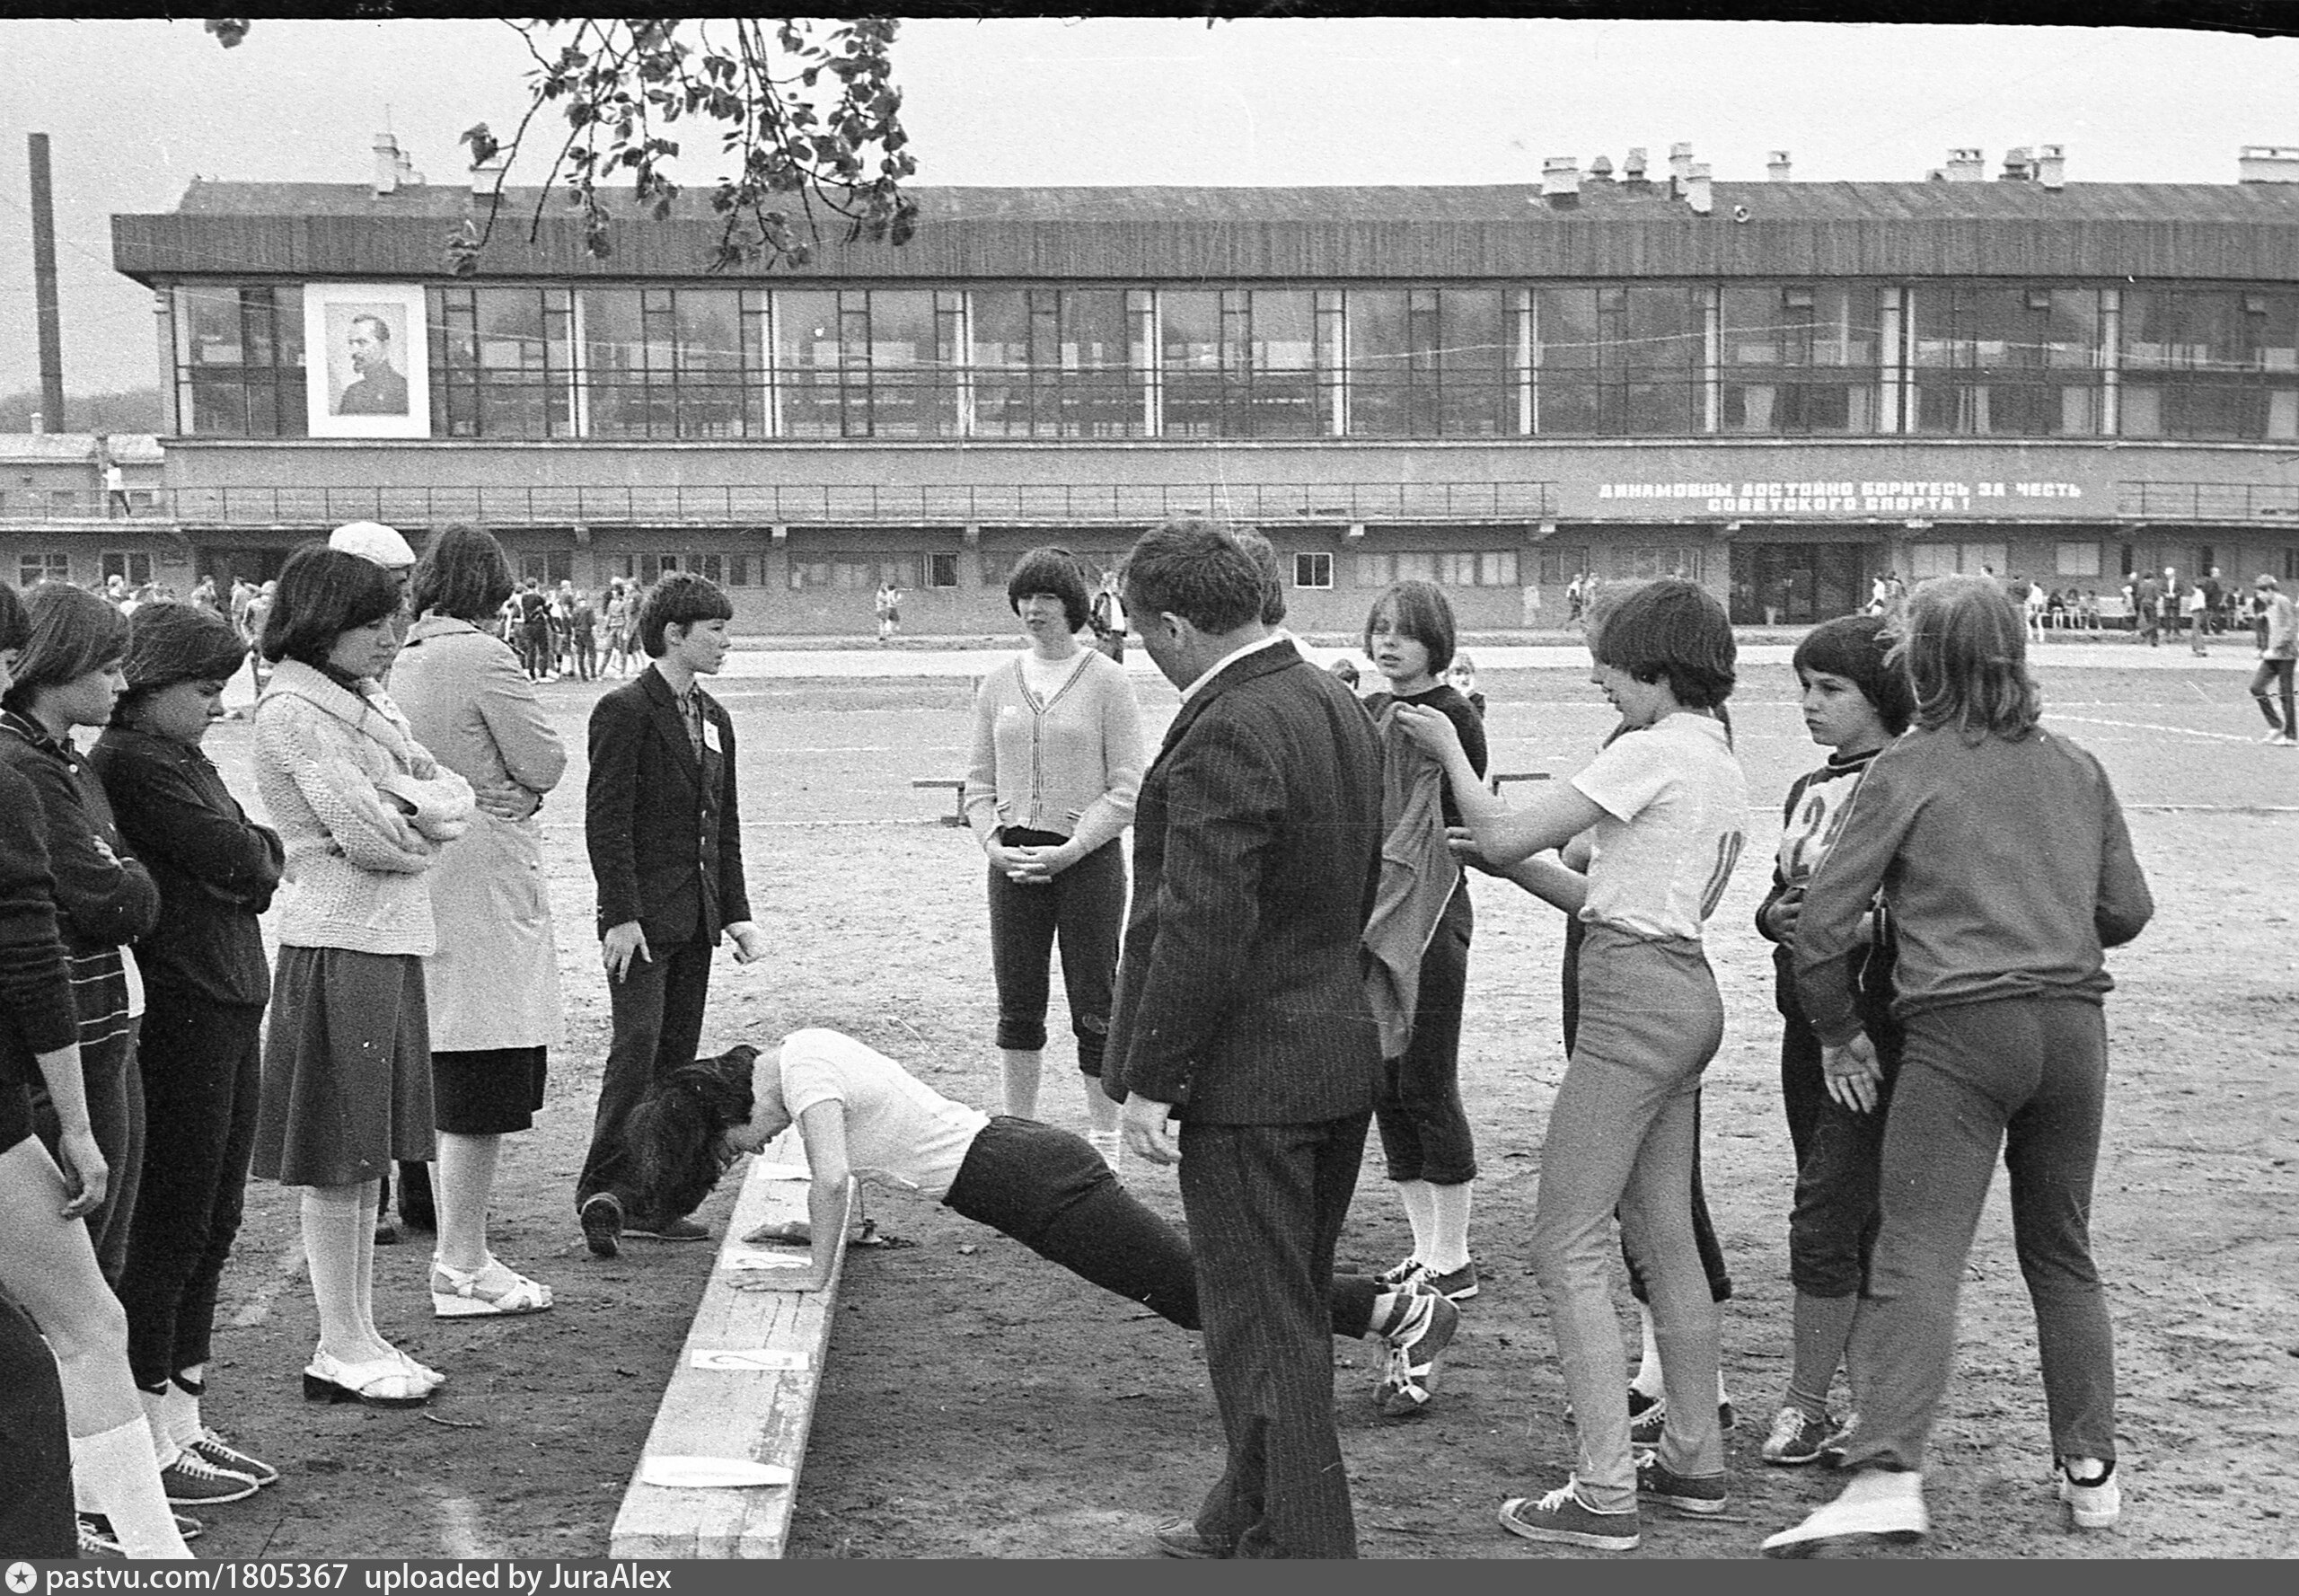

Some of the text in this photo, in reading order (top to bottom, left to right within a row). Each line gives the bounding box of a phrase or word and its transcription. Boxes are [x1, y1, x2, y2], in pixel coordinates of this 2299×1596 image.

[1599, 481, 2082, 498] ДИНАМОВЦЫ ДОСТОЙНО БОРИТЕСЬ ЗА ЧЕСТЬ
[1707, 497, 1856, 512] СОВЕТСКОГО
